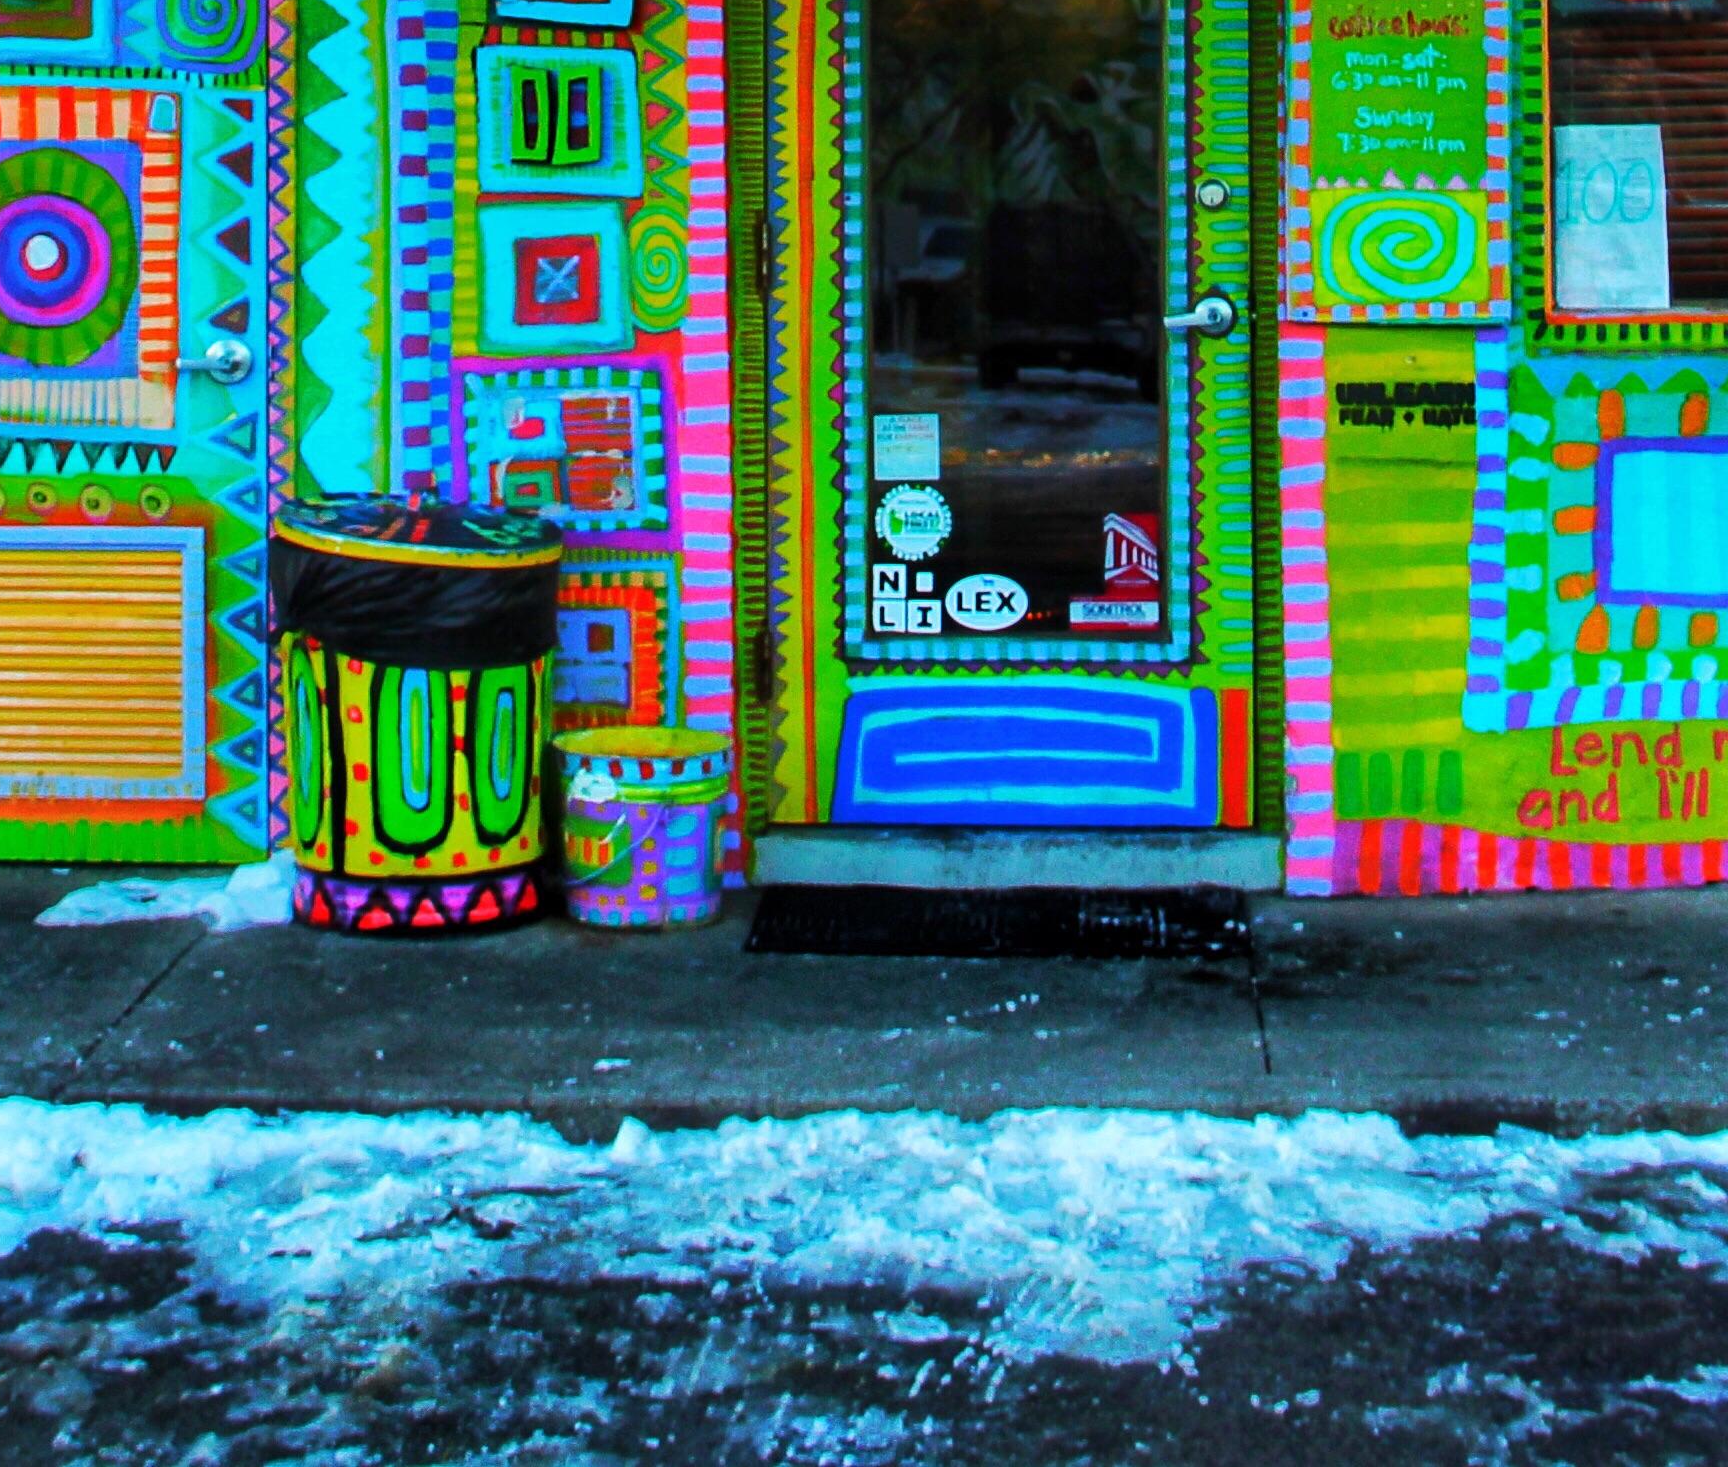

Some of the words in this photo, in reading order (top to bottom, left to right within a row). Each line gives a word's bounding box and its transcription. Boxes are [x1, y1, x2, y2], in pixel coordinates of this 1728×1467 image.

[1436, 75, 1469, 95] pm
[1353, 105, 1434, 132] Sunday
[1437, 138, 1466, 156] pm
[956, 590, 1017, 615] LEX
[1551, 722, 1685, 777] Lend
[1517, 770, 1621, 831] and
[1655, 765, 1710, 821] I'll
